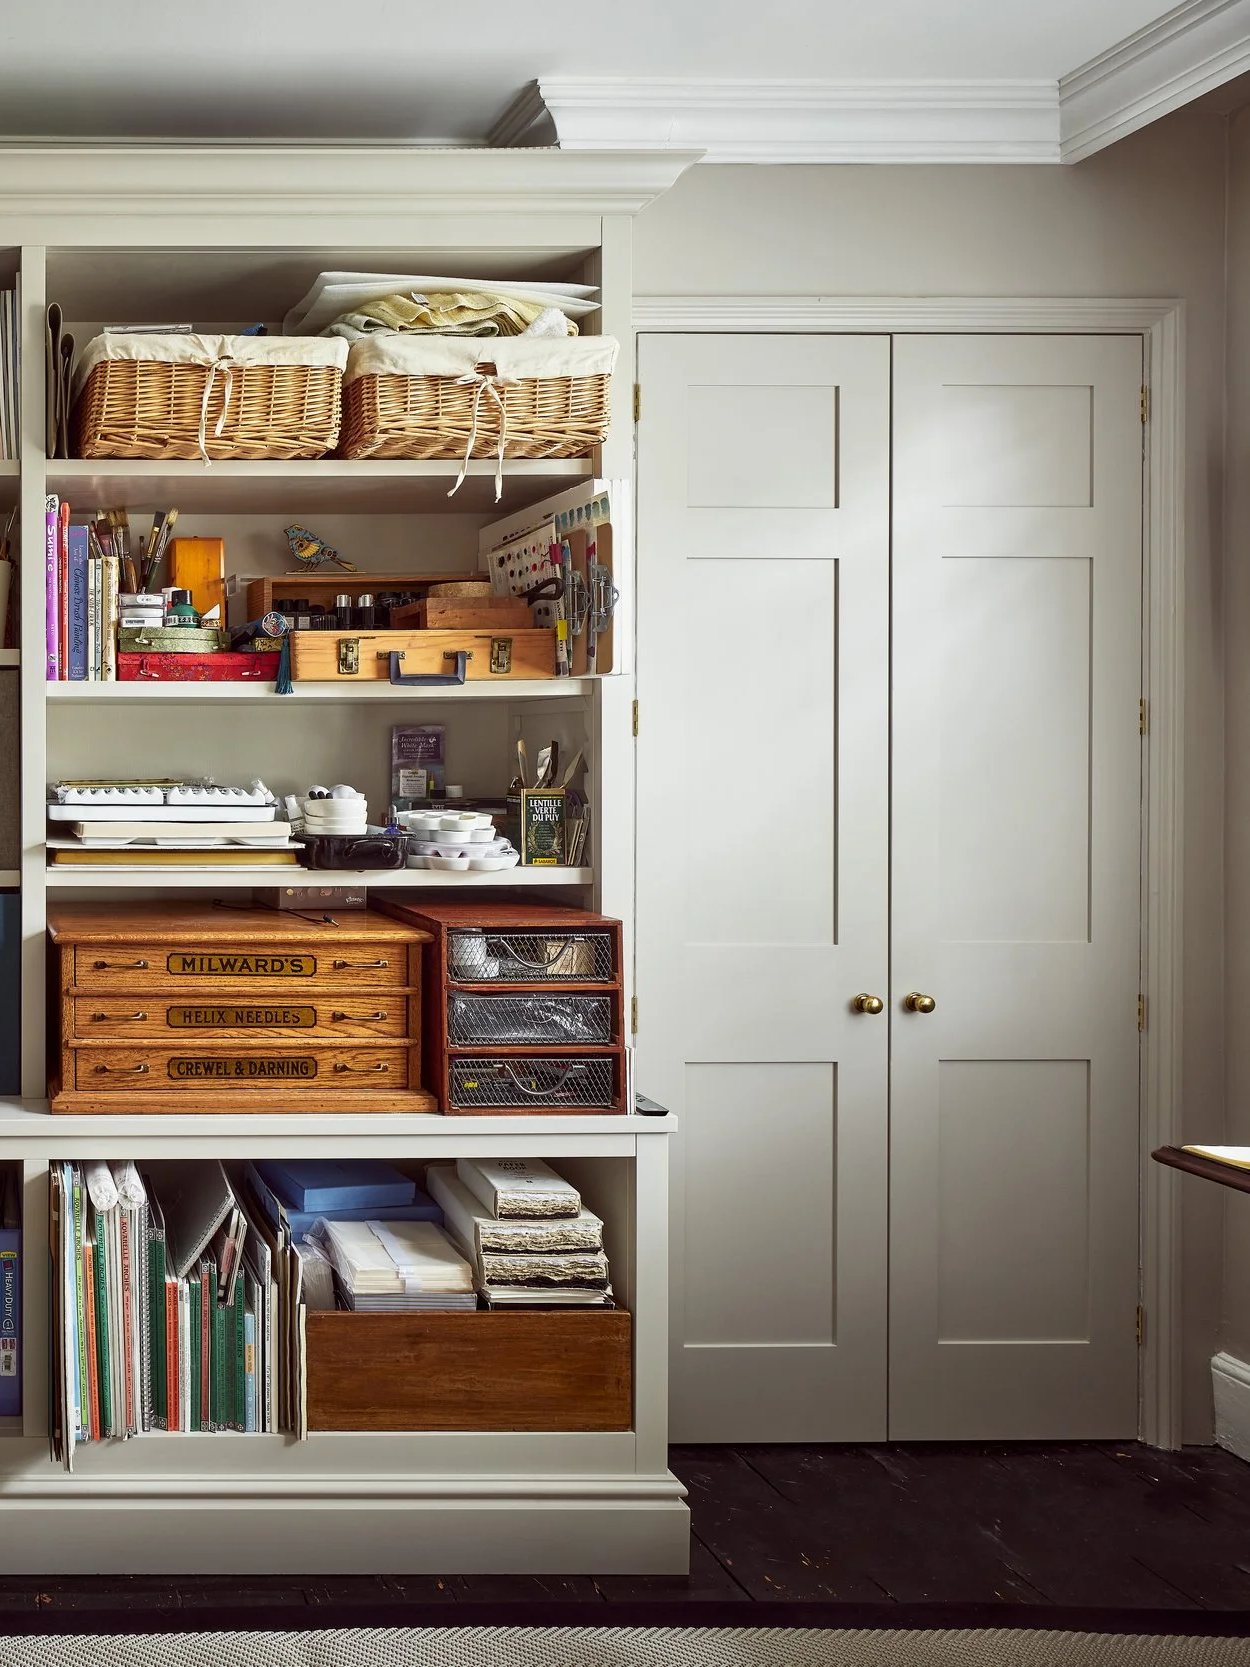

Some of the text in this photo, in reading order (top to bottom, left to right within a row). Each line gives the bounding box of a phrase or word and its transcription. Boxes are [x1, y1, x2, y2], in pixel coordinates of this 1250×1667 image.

[72, 568, 84, 654] Chinese Brush Painting
[535, 806, 557, 814] VERTE
[182, 958, 304, 972] MILWARD'S
[183, 1010, 300, 1024] HELIX NEEDLES
[177, 1061, 308, 1076] CREWEL & DARNING
[5, 1272, 13, 1316] HEAVY DUTY
